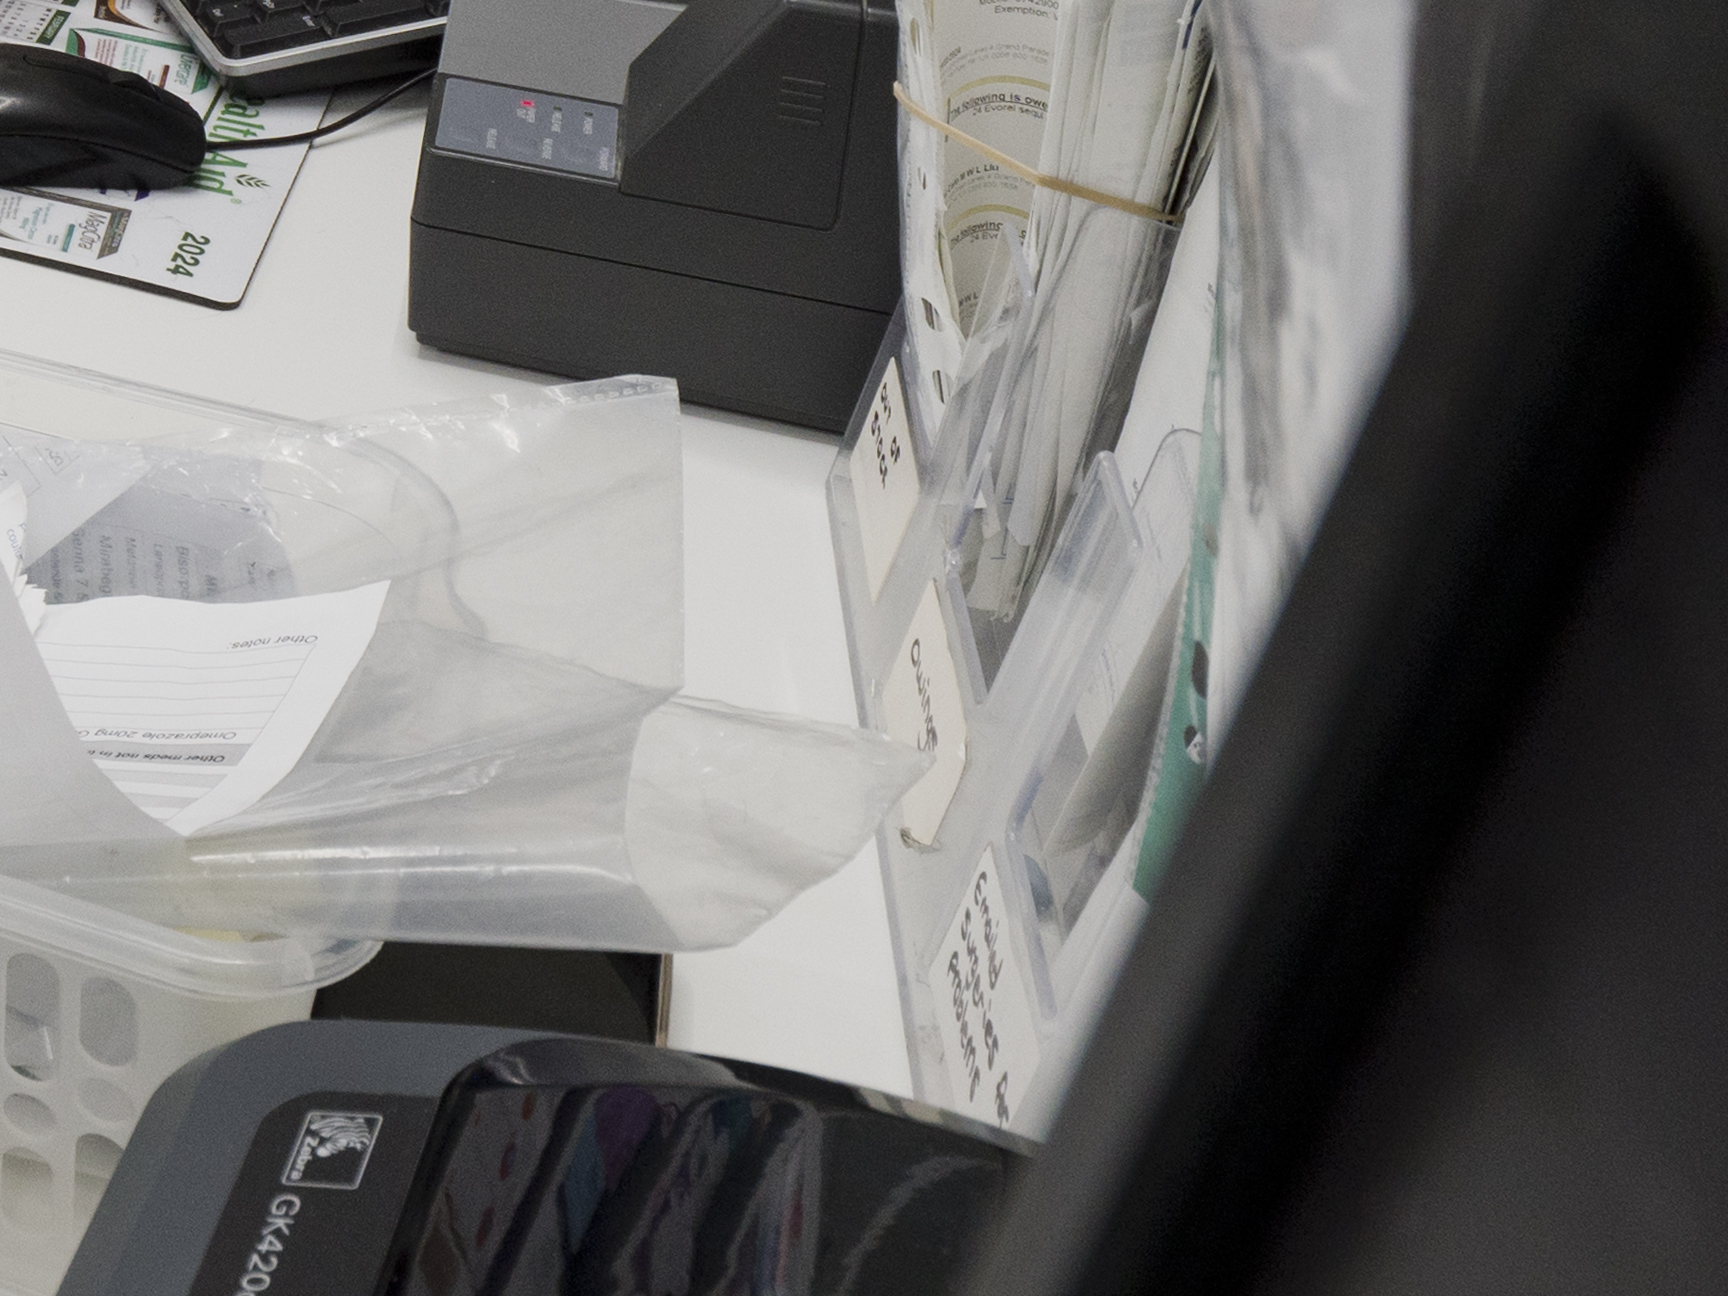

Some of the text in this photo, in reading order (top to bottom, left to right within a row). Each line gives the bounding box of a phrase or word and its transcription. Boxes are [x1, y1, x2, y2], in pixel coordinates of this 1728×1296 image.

[165, 230, 211, 278] 2024
[226, 634, 319, 651] Other notes:
[94, 727, 238, 741] Omeprazole 20mg
[143, 752, 226, 764] Other meds
[289, 1135, 320, 1181] Zebra
[235, 1191, 302, 1296] GK420
